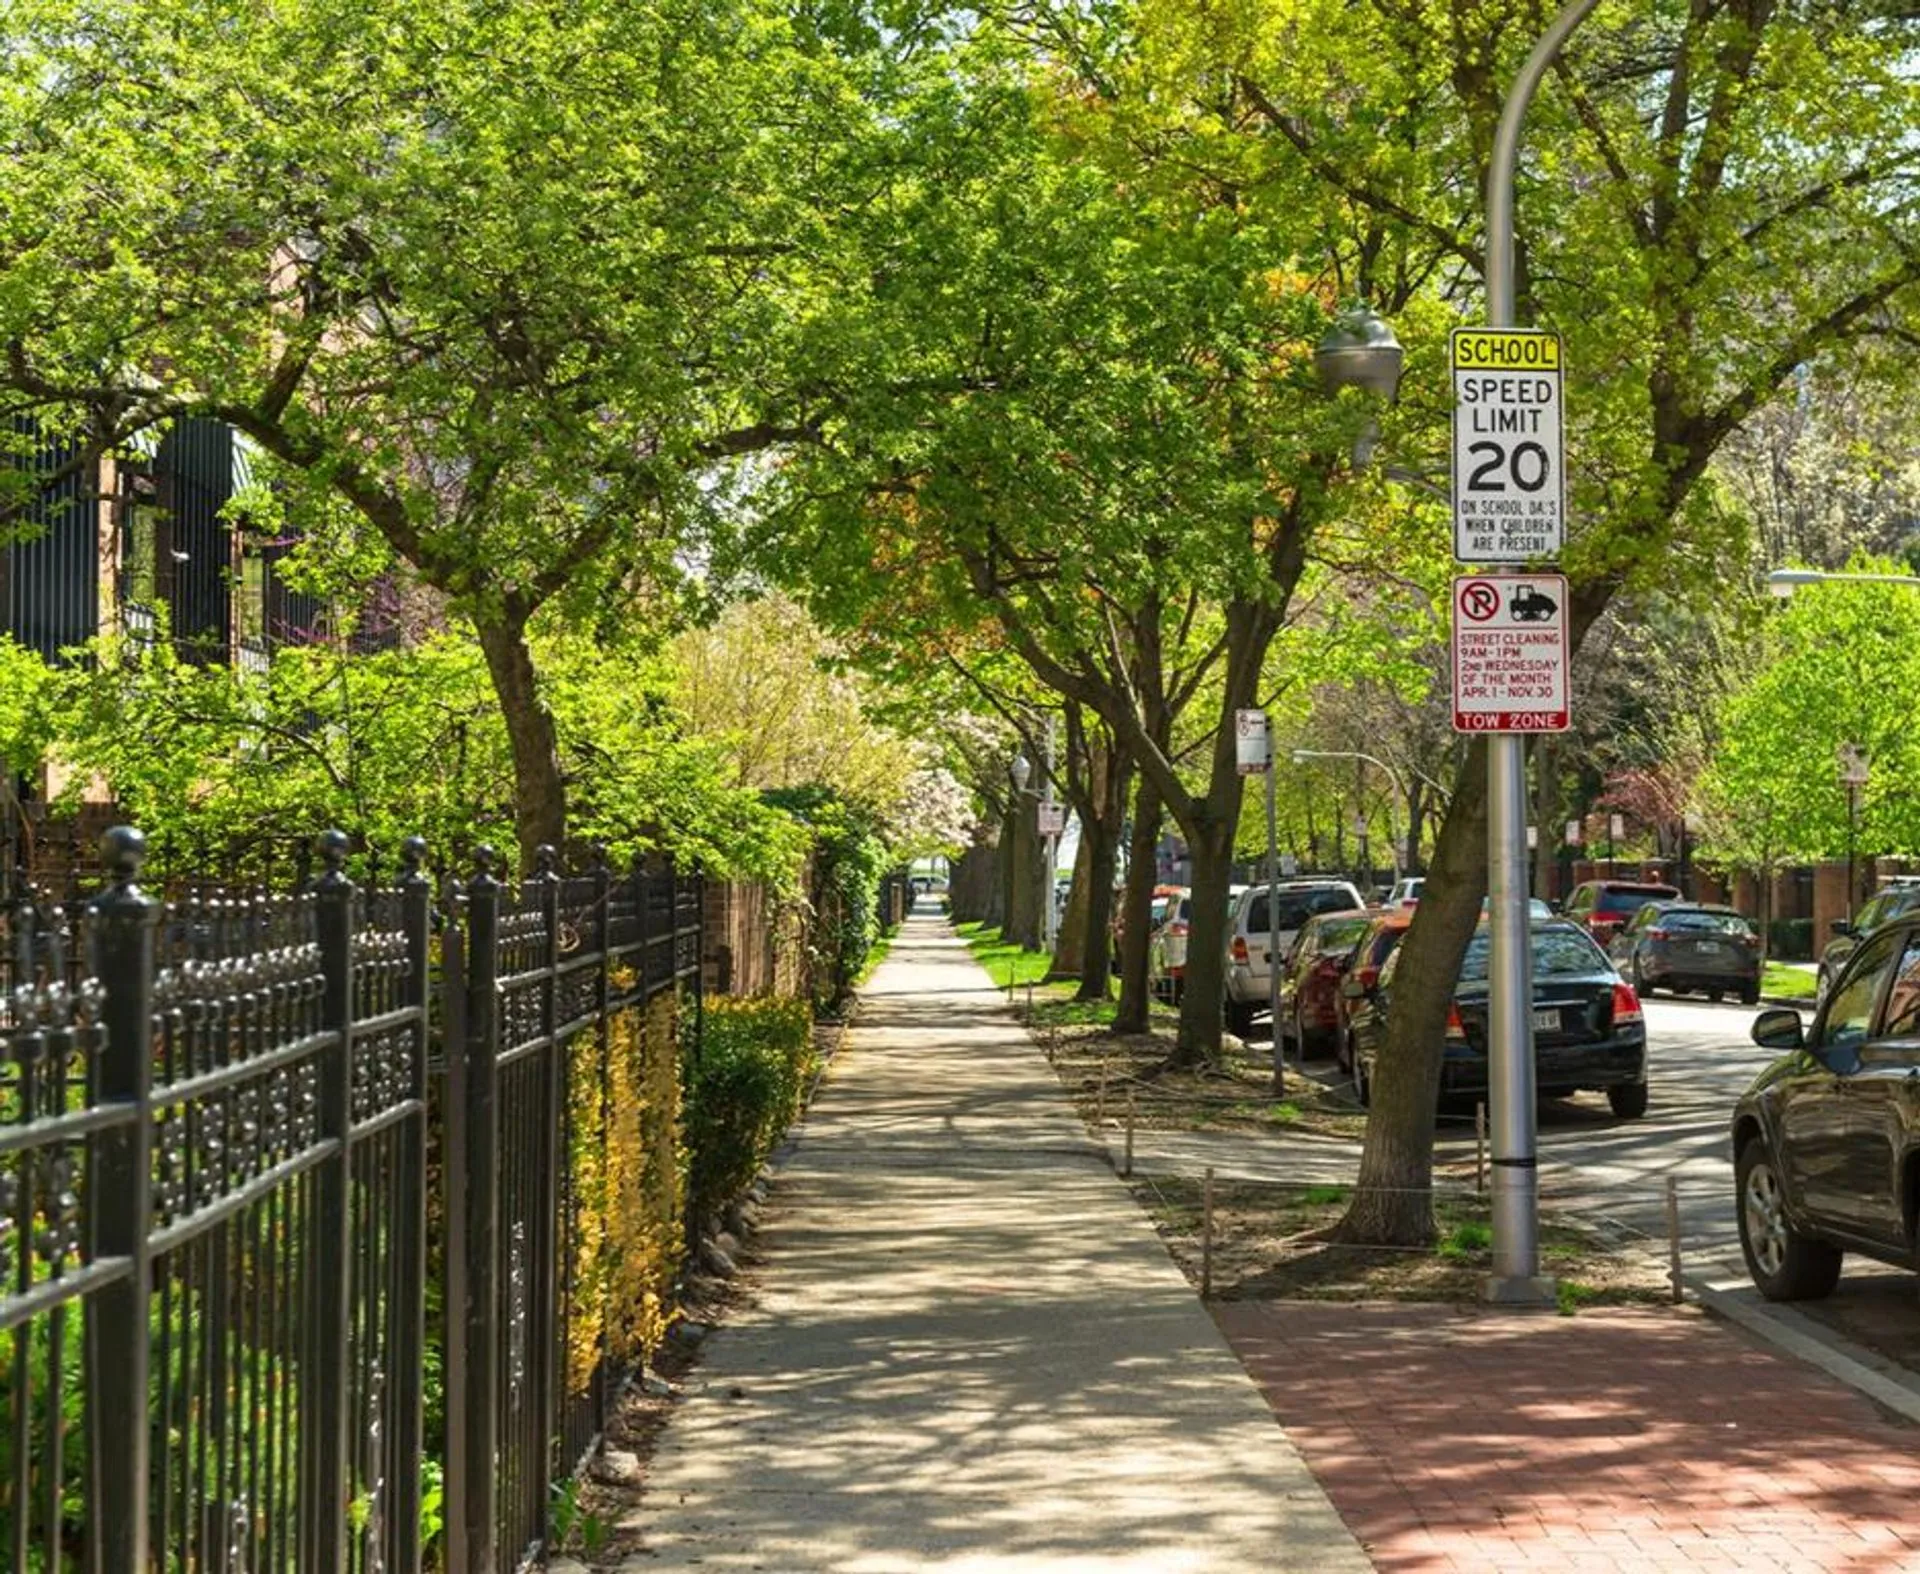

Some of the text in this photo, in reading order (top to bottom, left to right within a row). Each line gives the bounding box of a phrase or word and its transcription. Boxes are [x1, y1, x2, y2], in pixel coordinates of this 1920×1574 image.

[1459, 338, 1554, 364] SCHOOL
[1463, 379, 1552, 404] SPEED
[1473, 408, 1542, 432] LIMIT
[1468, 441, 1549, 492] 20
[1461, 500, 1476, 514] ON
[1481, 500, 1523, 515] SCHOOL
[1466, 518, 1553, 533] WHEN CHILDREN
[1473, 537, 1545, 550] ARE PRESENT
[1460, 633, 1559, 645] STREET CLEANING
[1485, 661, 1559, 671] WEDNESDAY
[1461, 673, 1551, 685] OF THE MONTH
[1462, 714, 1559, 729] TOW ZONE
